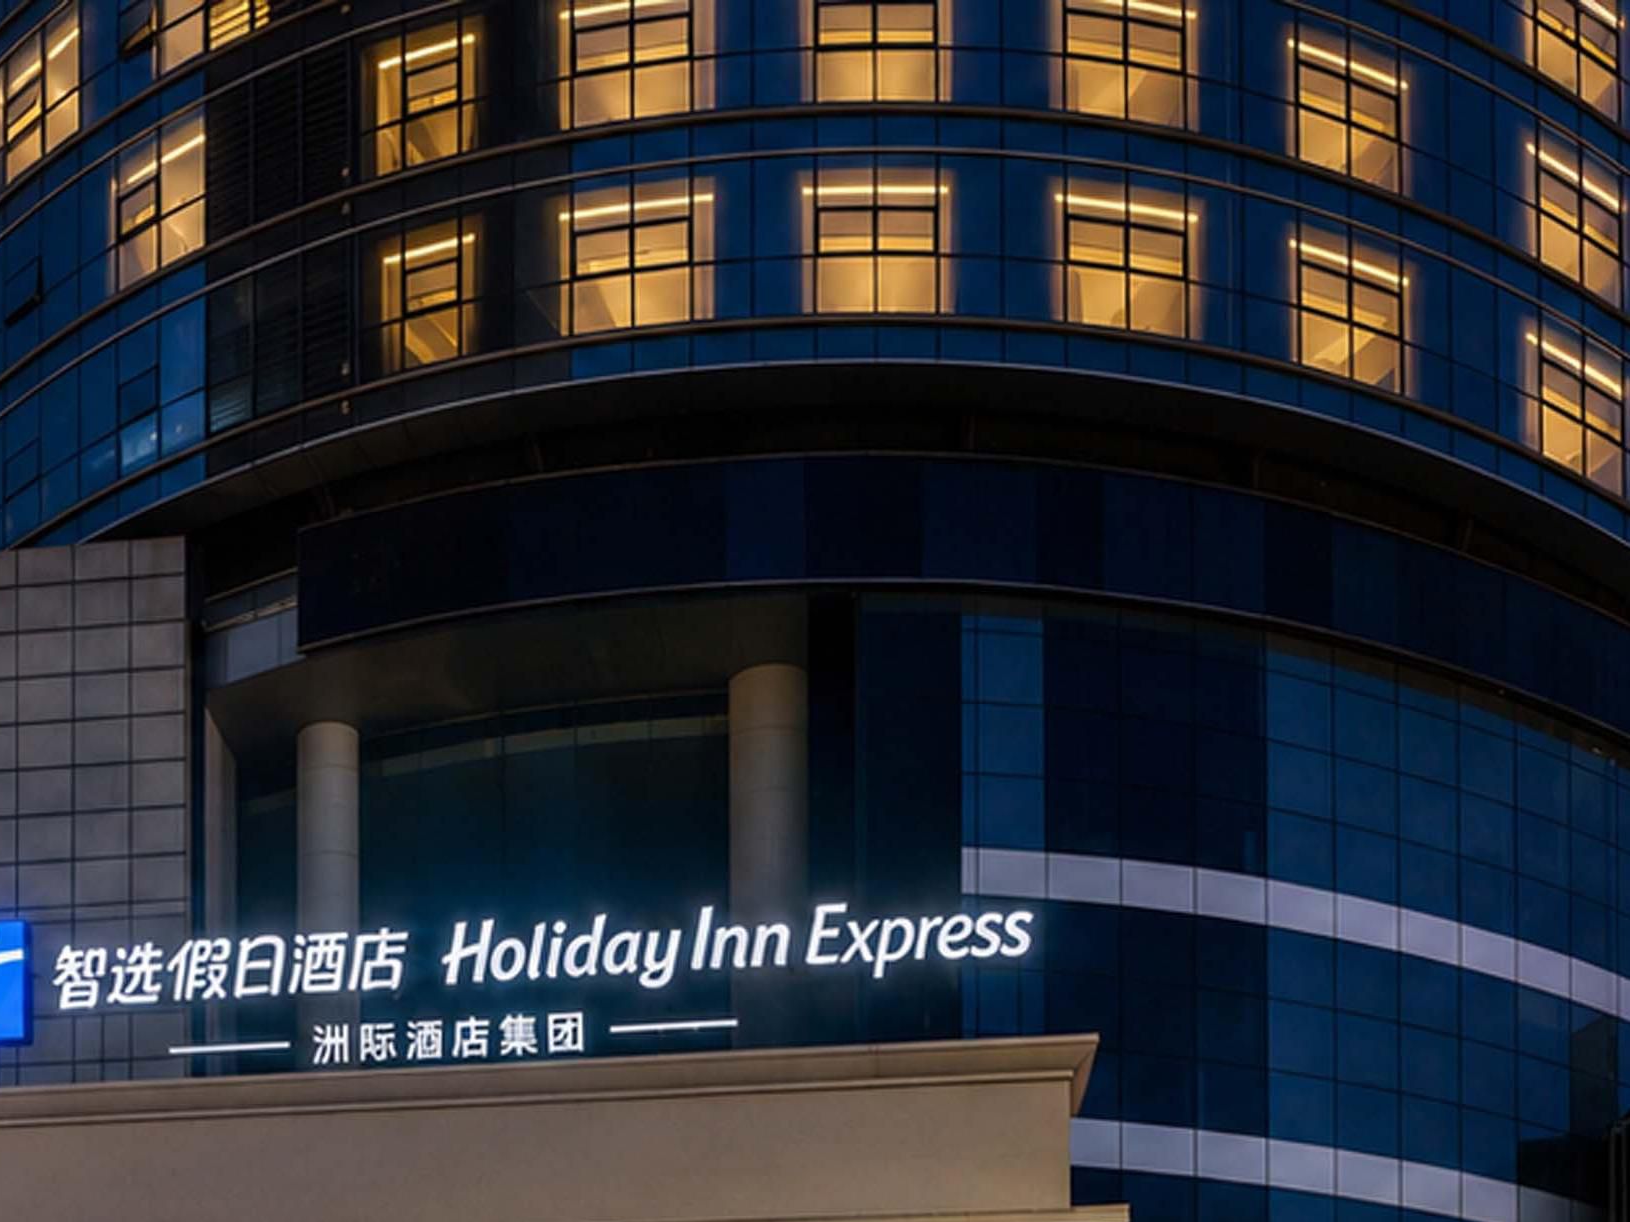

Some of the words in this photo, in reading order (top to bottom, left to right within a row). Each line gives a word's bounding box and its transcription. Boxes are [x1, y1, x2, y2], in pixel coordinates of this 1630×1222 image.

[53, 927, 409, 1010] 智选假日酒店
[441, 913, 682, 988] Holiday
[690, 905, 791, 970] Inn
[805, 902, 1034, 978] Express
[312, 1011, 585, 1065] 洲际酒店集团
